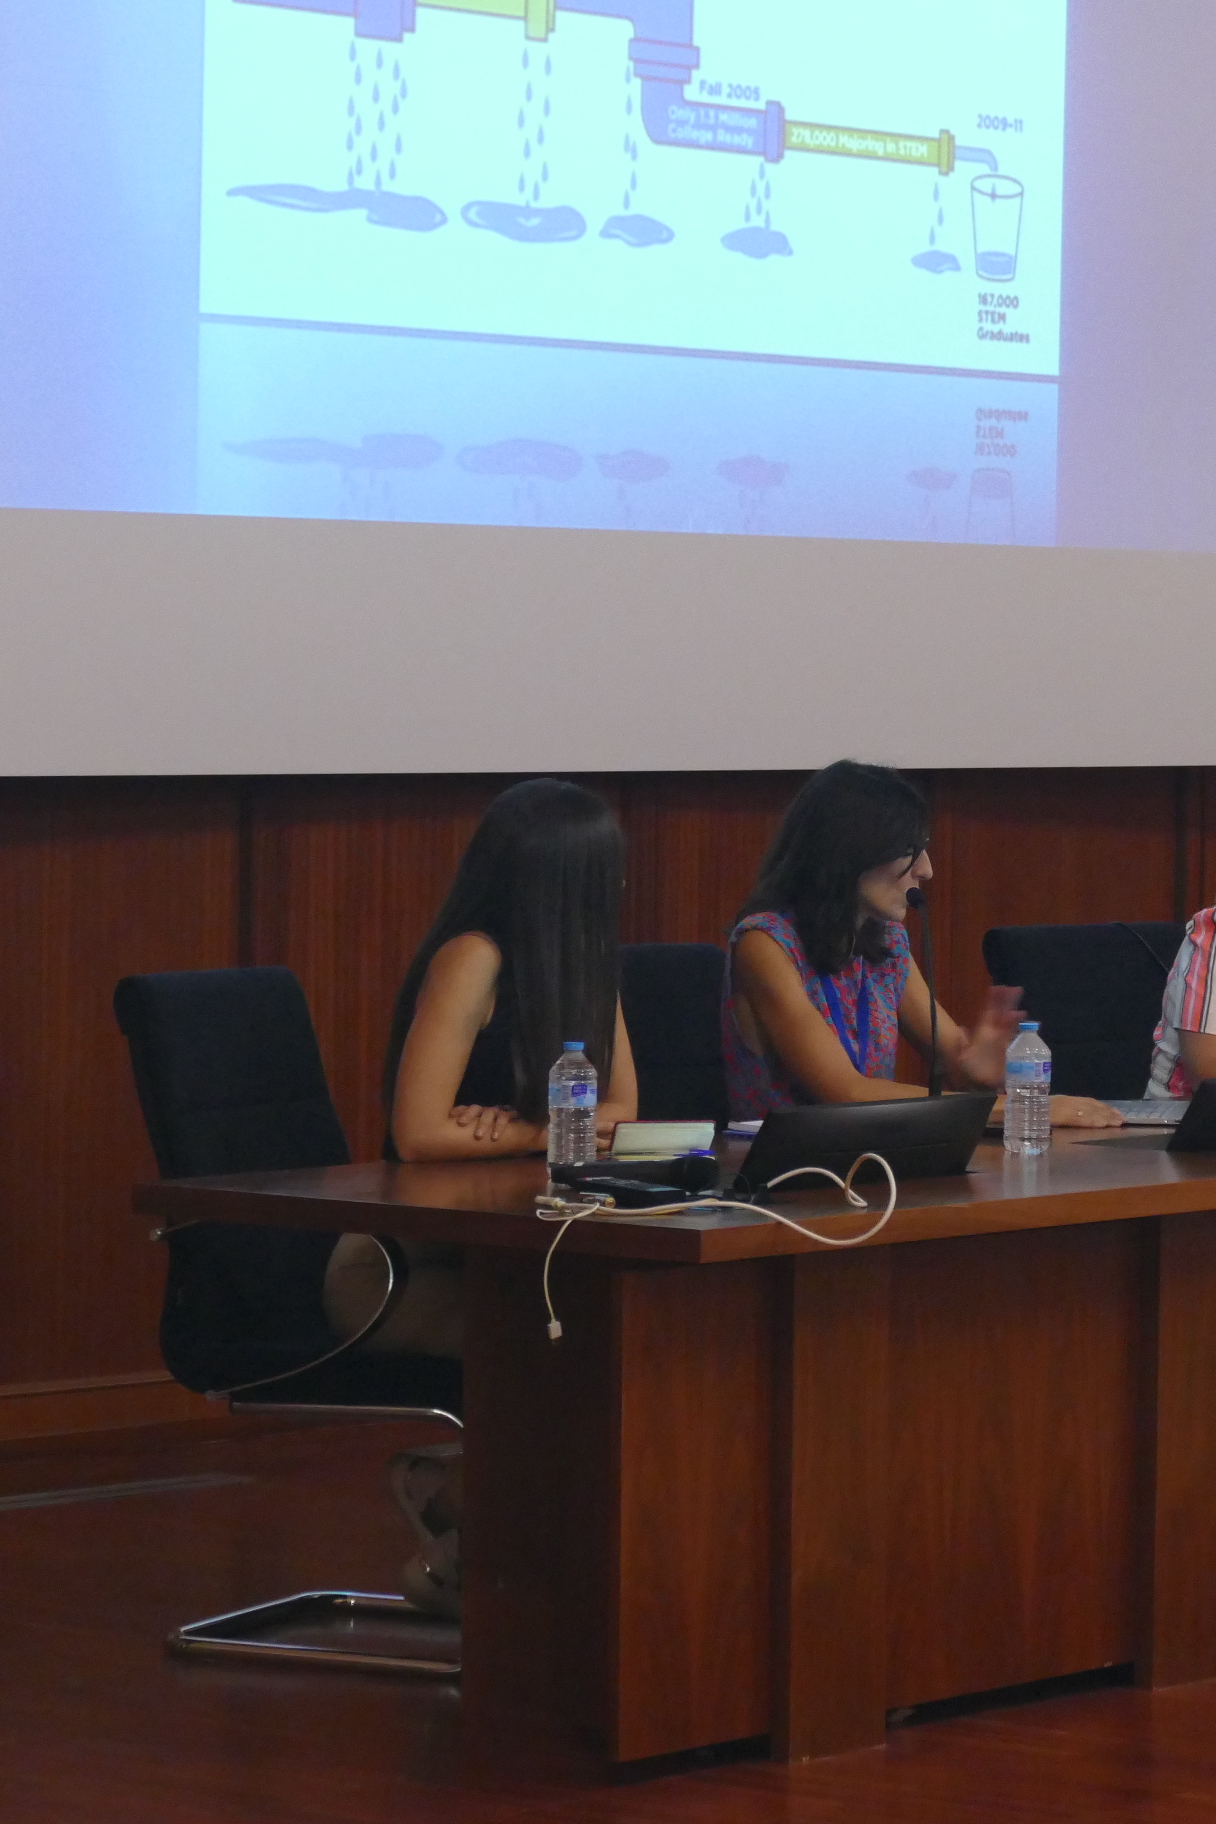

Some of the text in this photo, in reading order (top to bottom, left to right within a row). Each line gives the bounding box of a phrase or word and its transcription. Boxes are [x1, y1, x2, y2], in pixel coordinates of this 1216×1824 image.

[699, 79, 761, 101] Fall 2005
[668, 104, 696, 126] Only
[976, 113, 1023, 132] 2009-11
[667, 122, 754, 149] College Ready
[898, 141, 928, 158] STEM
[977, 292, 1020, 309] 167,000
[977, 309, 1007, 325] STEM
[976, 326, 1031, 344] Graduates
